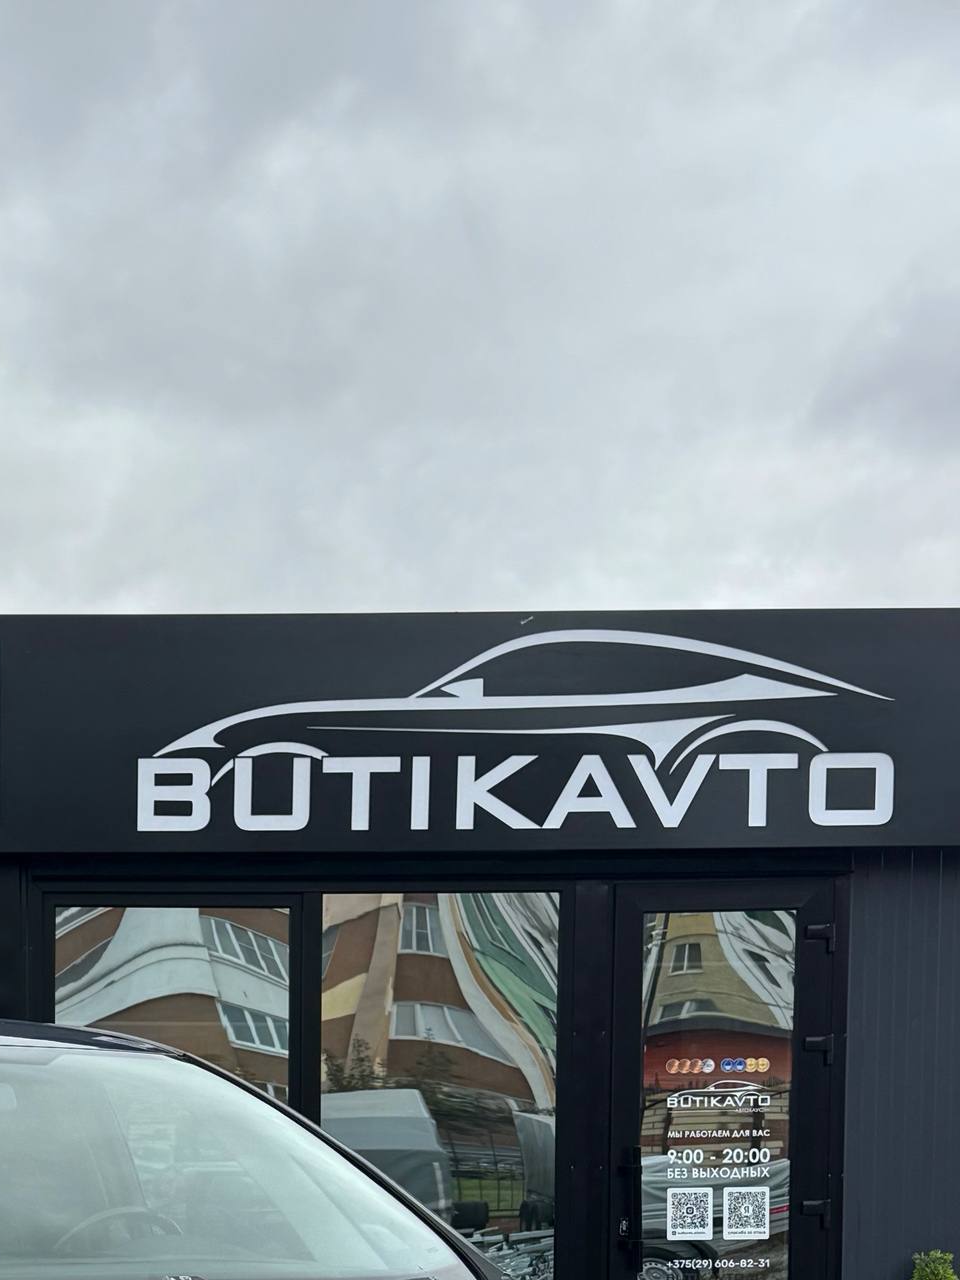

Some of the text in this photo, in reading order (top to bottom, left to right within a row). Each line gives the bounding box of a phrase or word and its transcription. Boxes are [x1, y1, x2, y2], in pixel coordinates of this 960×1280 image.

[137, 751, 895, 832] BUTIKAVTO
[667, 1095, 771, 1108] BUTIKAVTO
[667, 1129, 771, 1138] МЫ РАБОТАЕМ ДЛЯ ВАС
[667, 1149, 703, 1164] 9:00
[722, 1148, 771, 1164] 20:00
[667, 1167, 770, 1179] БЕЗ ВЫХОДНЫХ
[666, 1258, 770, 1269] +375(29) 606-82-31
